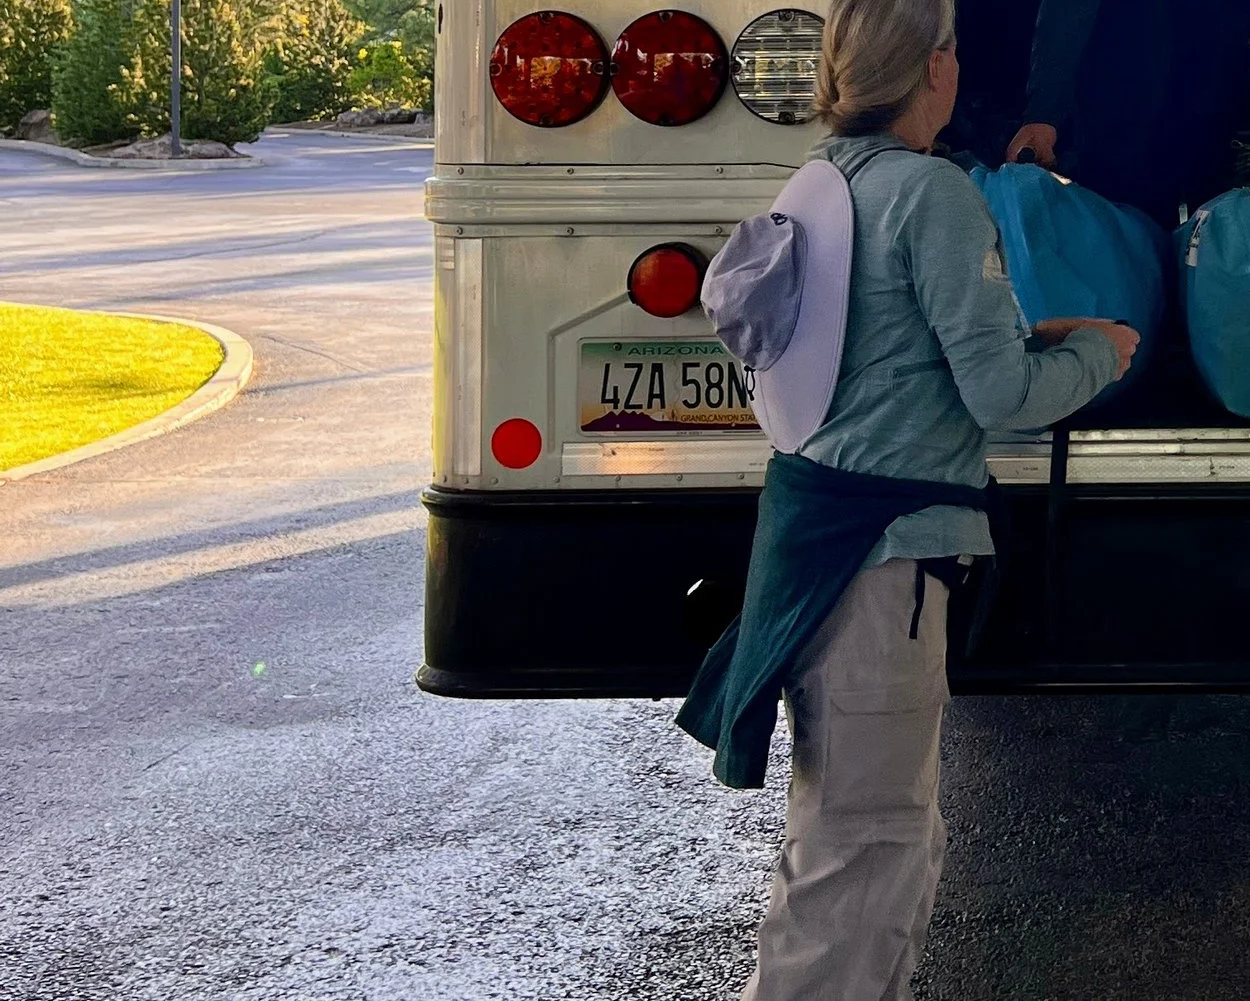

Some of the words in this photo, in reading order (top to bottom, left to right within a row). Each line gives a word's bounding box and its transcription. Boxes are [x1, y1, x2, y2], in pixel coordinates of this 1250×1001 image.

[627, 346, 724, 356] ARIZONA
[600, 363, 666, 410] 4ZA
[681, 361, 747, 409] 58N
[680, 413, 706, 423] GRAND
[707, 413, 739, 423] CANYON
[740, 413, 757, 422] STA
